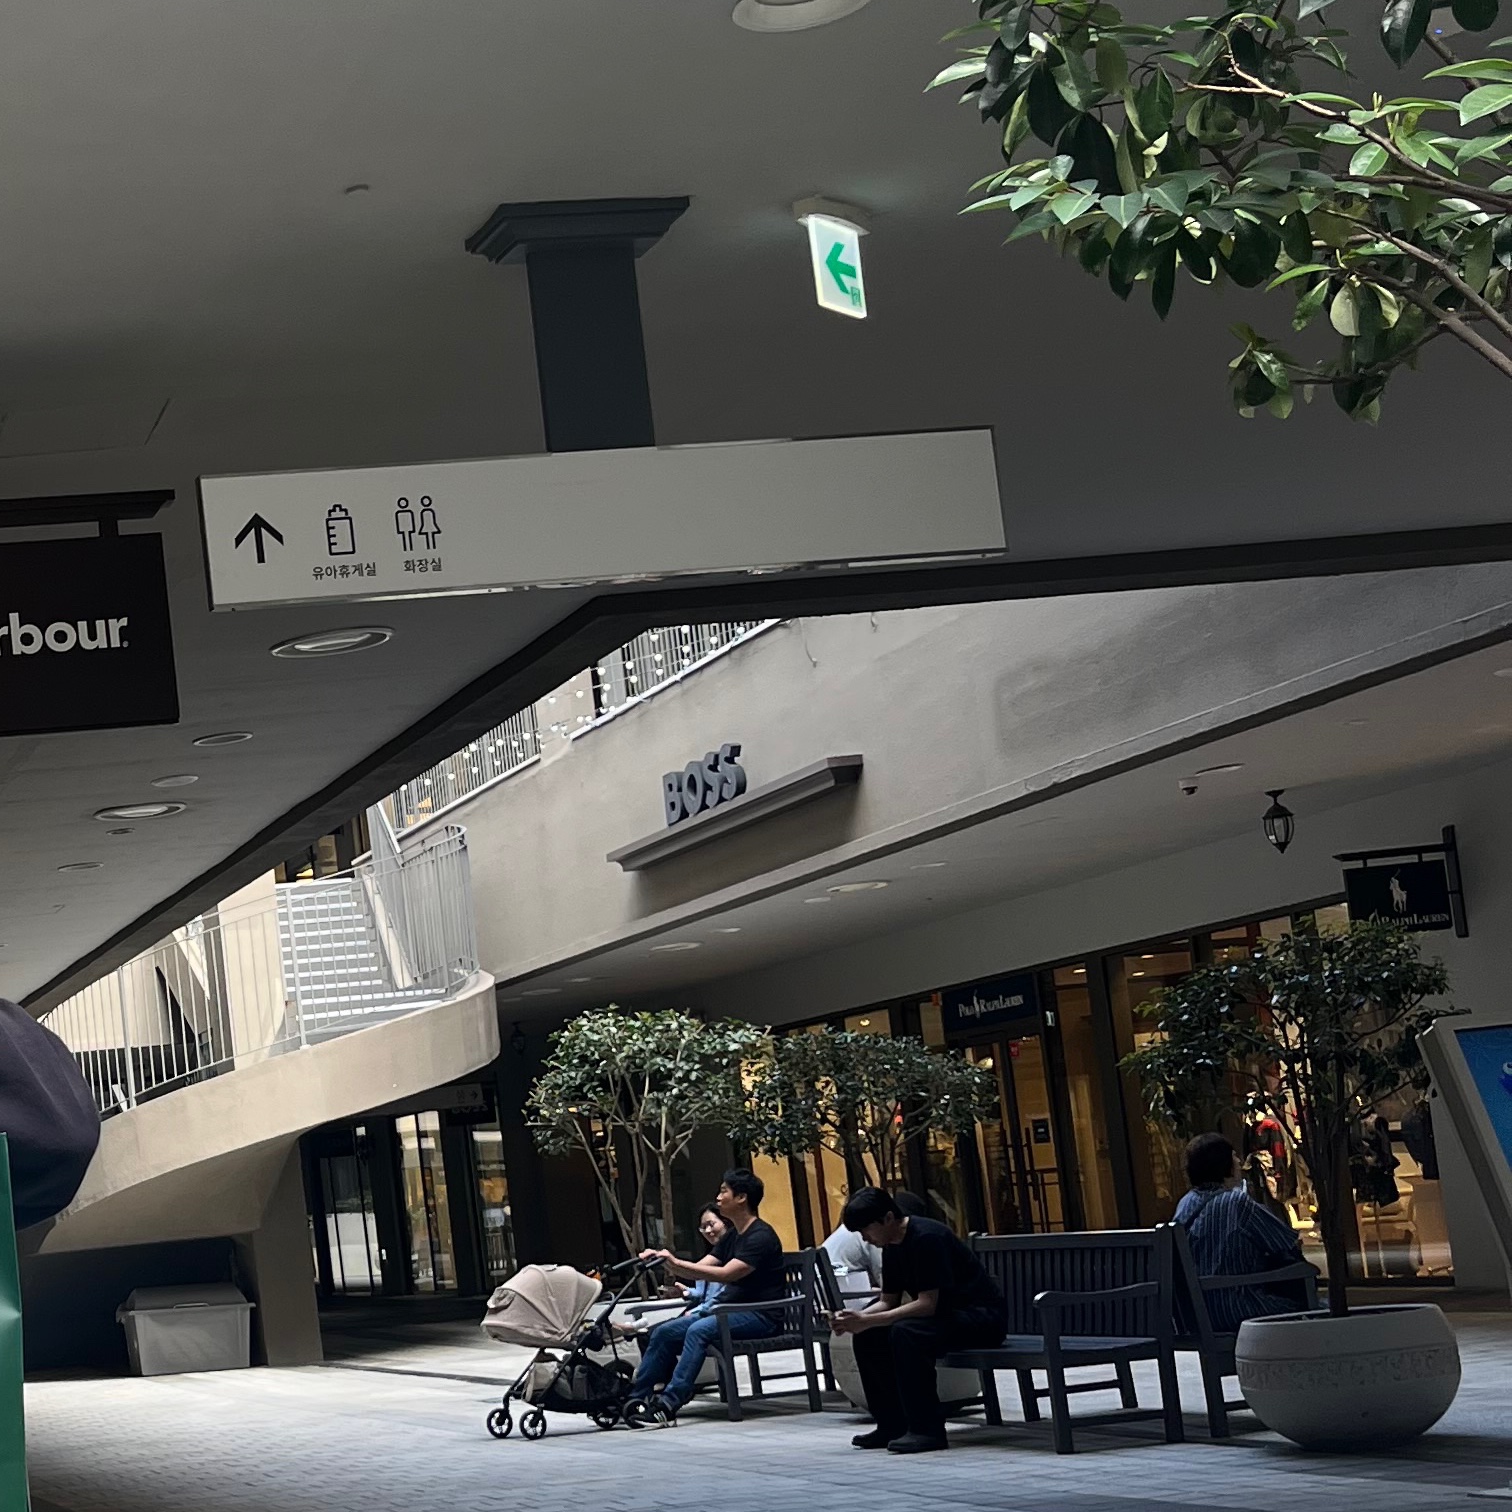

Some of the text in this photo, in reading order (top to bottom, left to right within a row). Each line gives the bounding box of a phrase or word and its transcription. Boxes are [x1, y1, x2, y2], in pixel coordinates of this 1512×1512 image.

[312, 561, 377, 581] 유아휴게실
[403, 557, 443, 574] 화장실
[662, 742, 747, 827] BOSS
